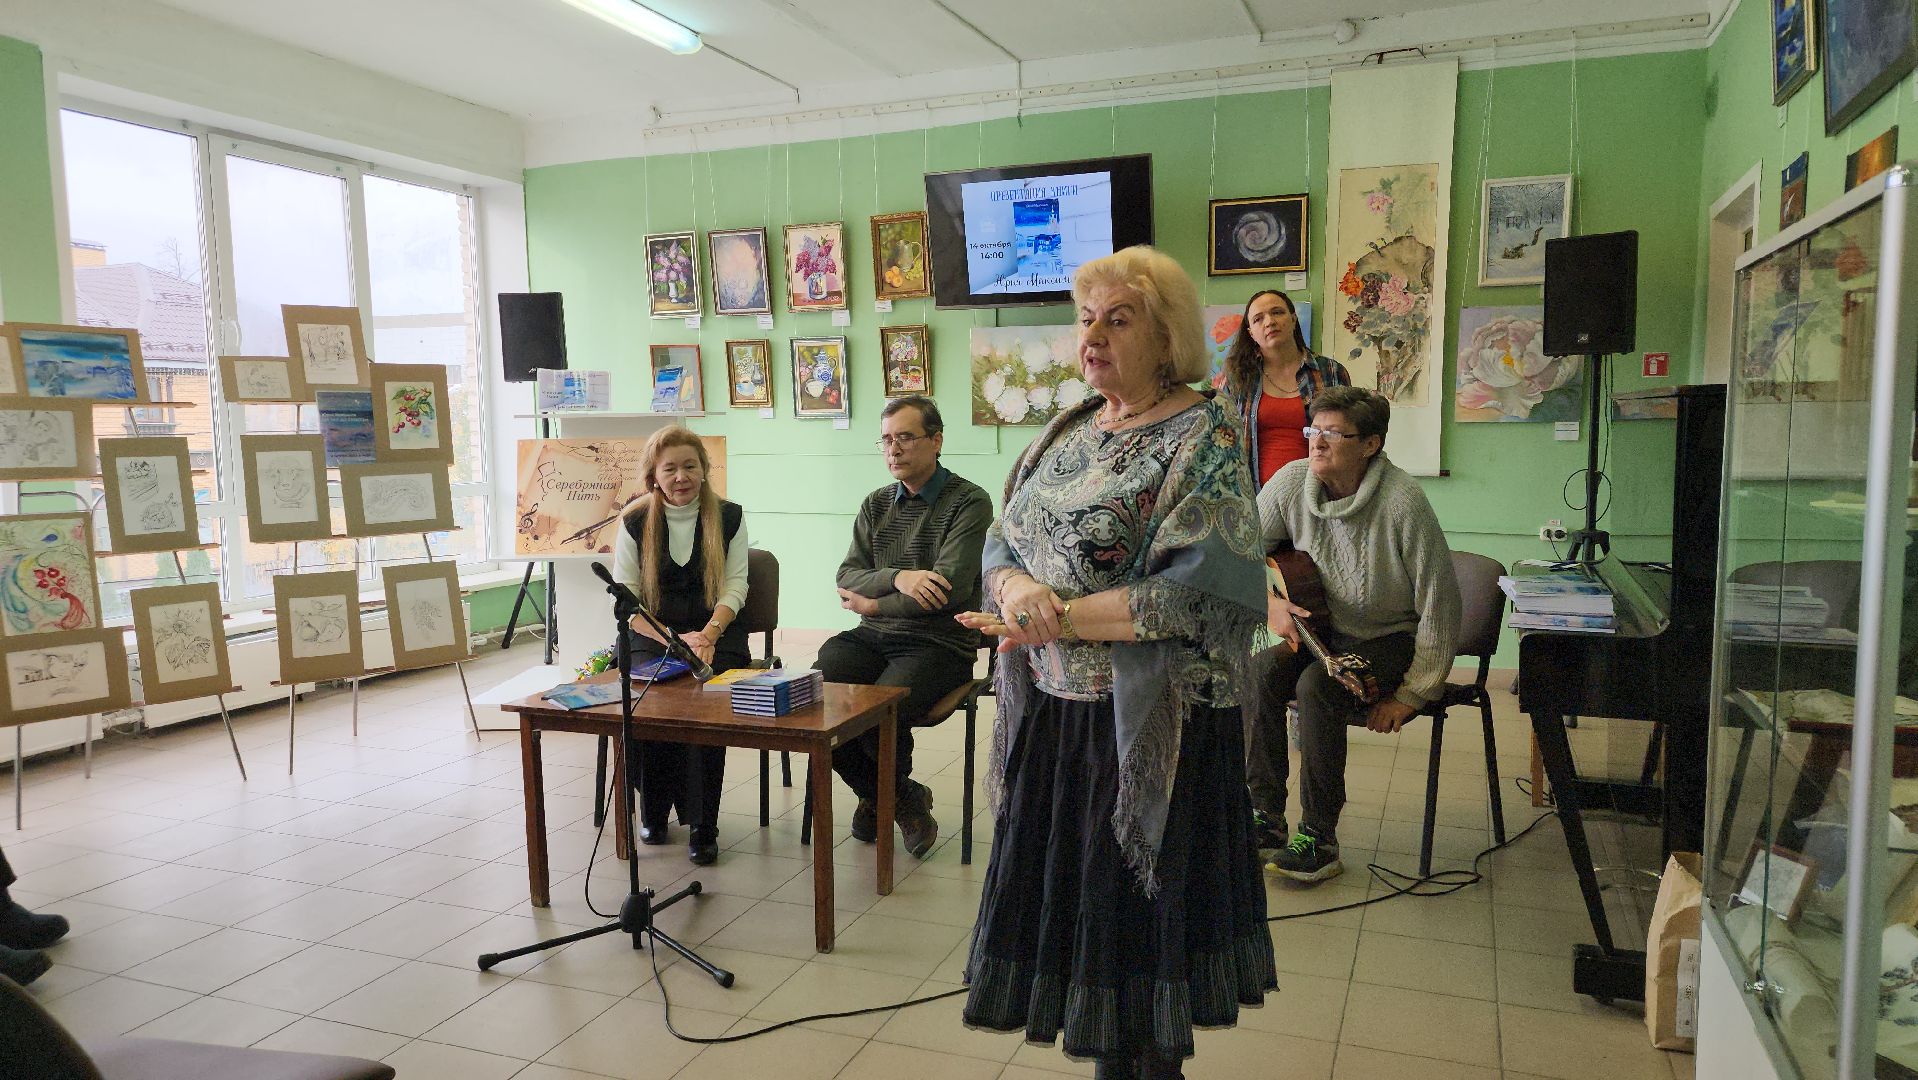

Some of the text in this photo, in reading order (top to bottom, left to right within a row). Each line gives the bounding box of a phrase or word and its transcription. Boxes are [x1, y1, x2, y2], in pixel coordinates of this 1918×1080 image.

[969, 240, 1012, 250] 14 октября
[980, 251, 1004, 260] 14:00
[546, 479, 617, 493] Серебряная
[566, 490, 601, 501] Нить
